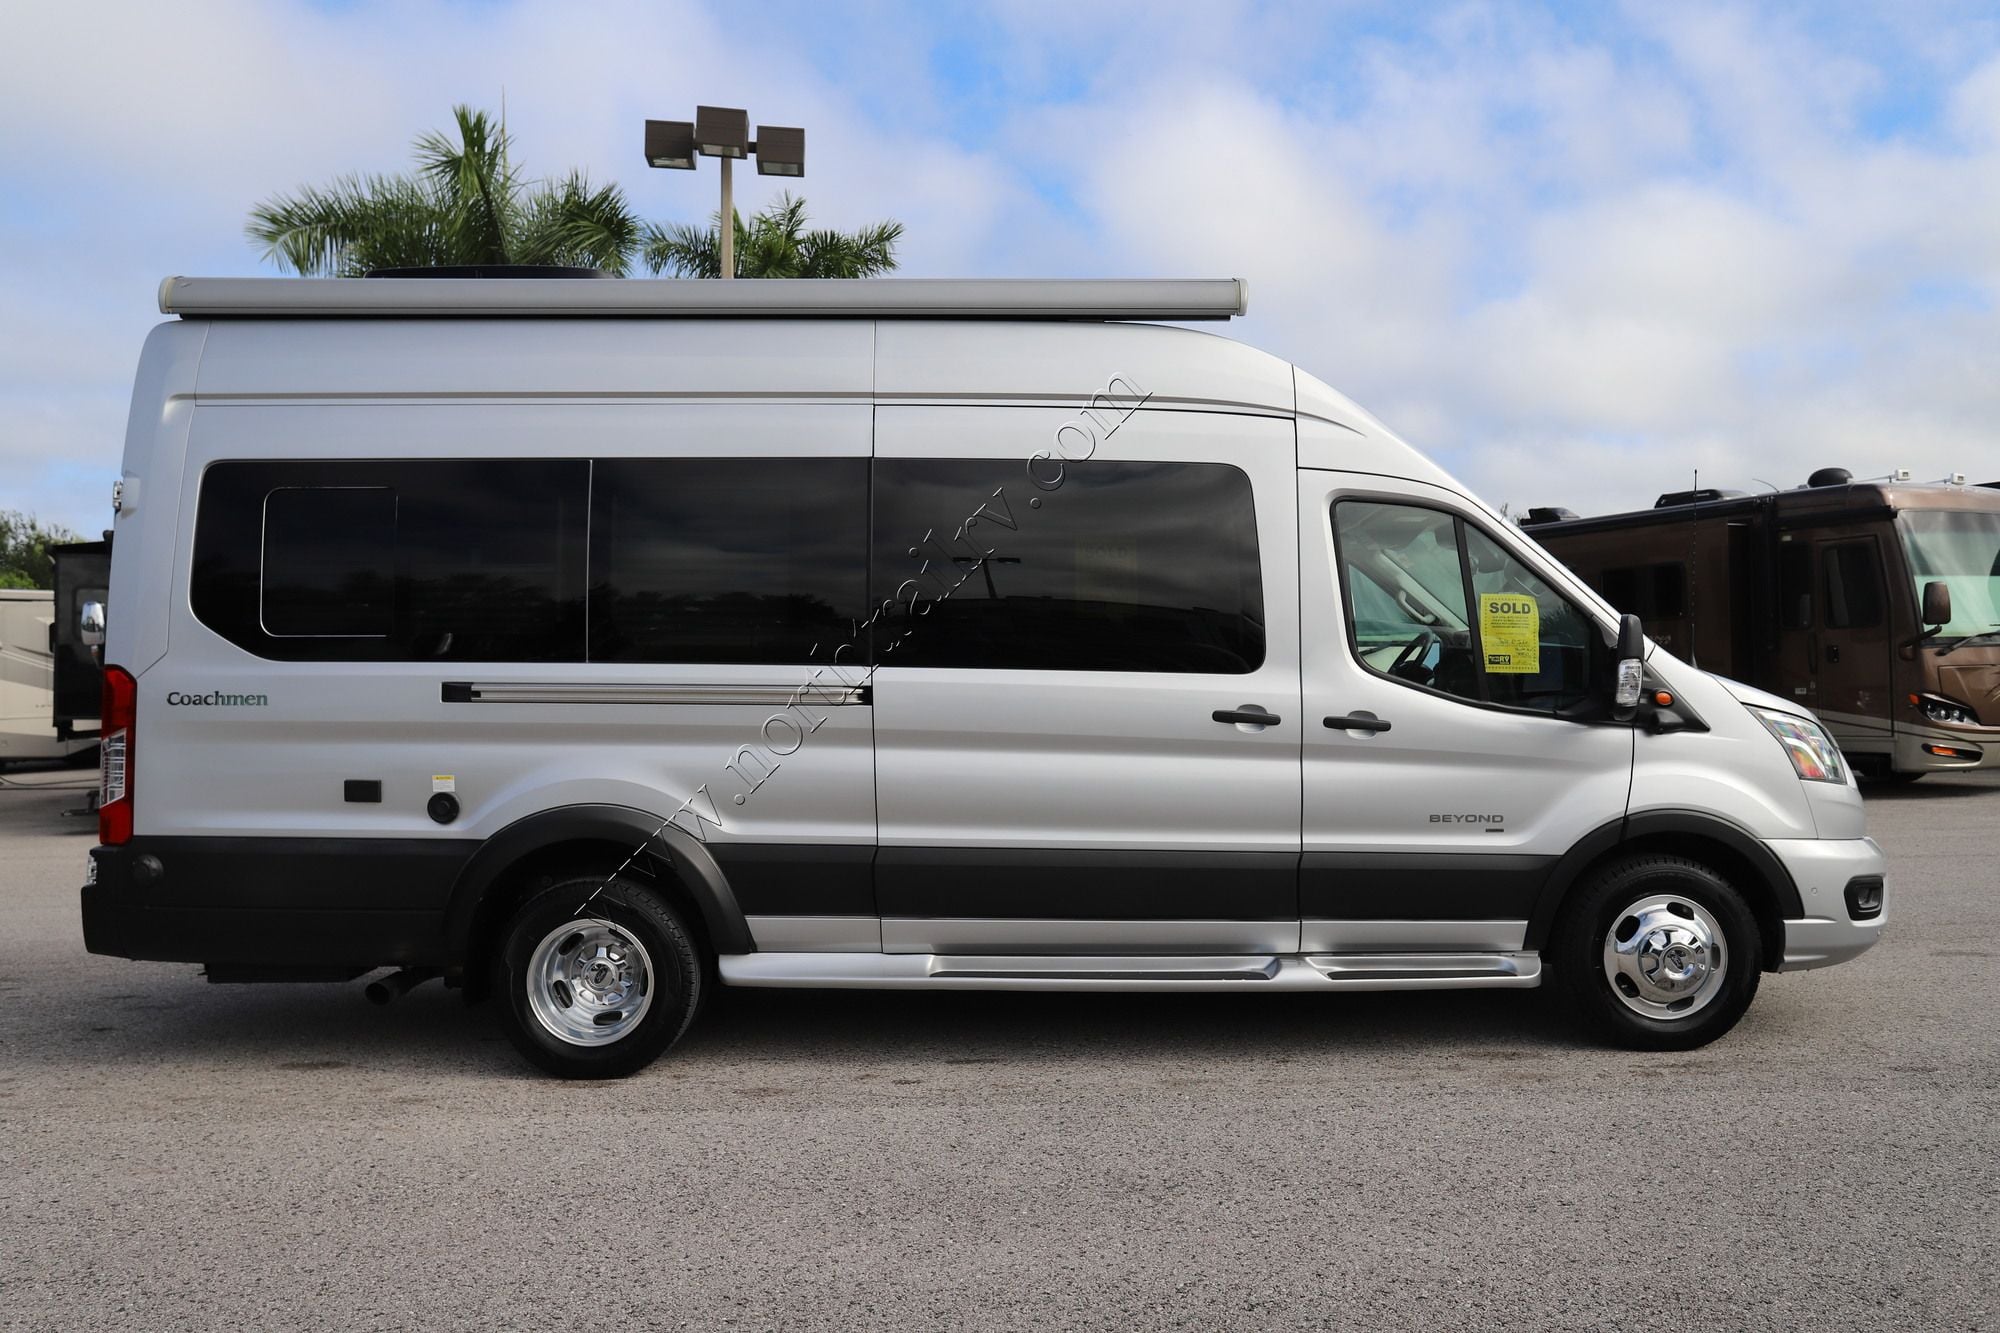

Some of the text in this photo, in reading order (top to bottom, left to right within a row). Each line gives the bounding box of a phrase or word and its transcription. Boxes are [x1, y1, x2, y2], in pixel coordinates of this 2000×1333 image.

[1489, 602, 1531, 614] SOLD
[167, 690, 269, 706] Coachmen
[1429, 814, 1504, 823] BEYOND
